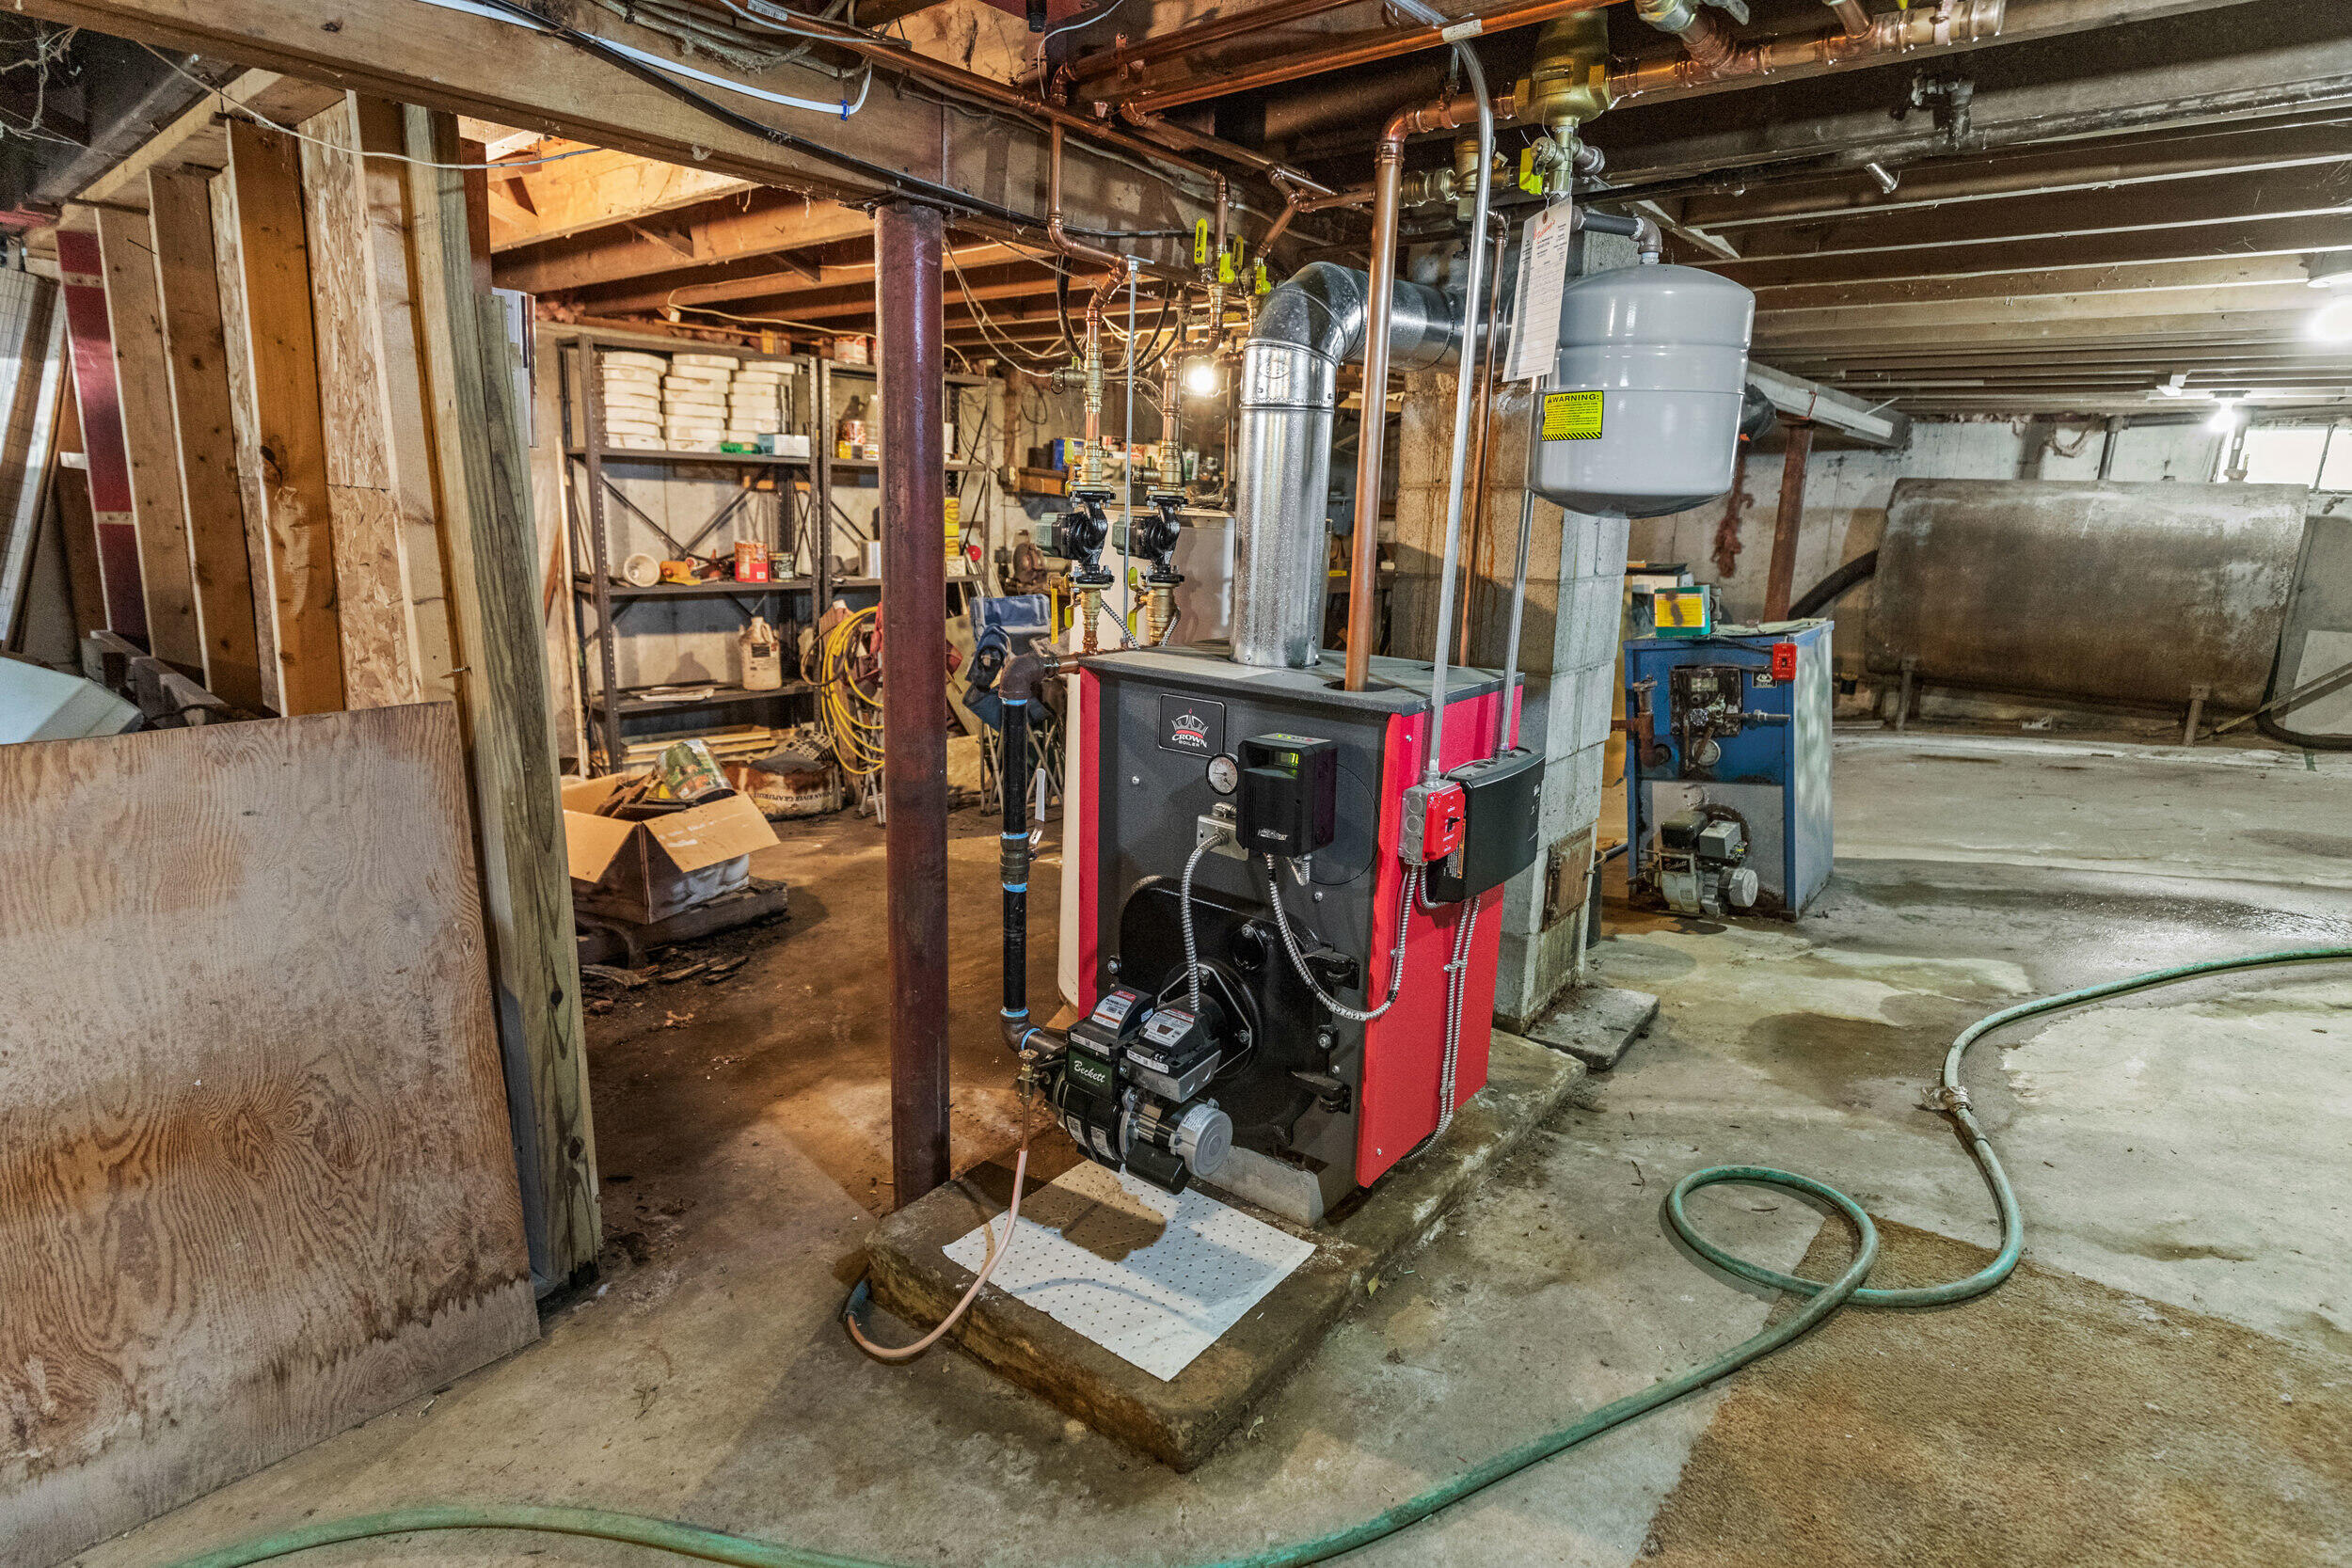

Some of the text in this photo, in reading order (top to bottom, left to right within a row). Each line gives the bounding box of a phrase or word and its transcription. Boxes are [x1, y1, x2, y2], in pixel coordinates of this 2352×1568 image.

[1552, 393, 1599, 403] WARNING:
[1171, 734, 1207, 748] CROWN
[1073, 1060, 1106, 1083] Beckett
